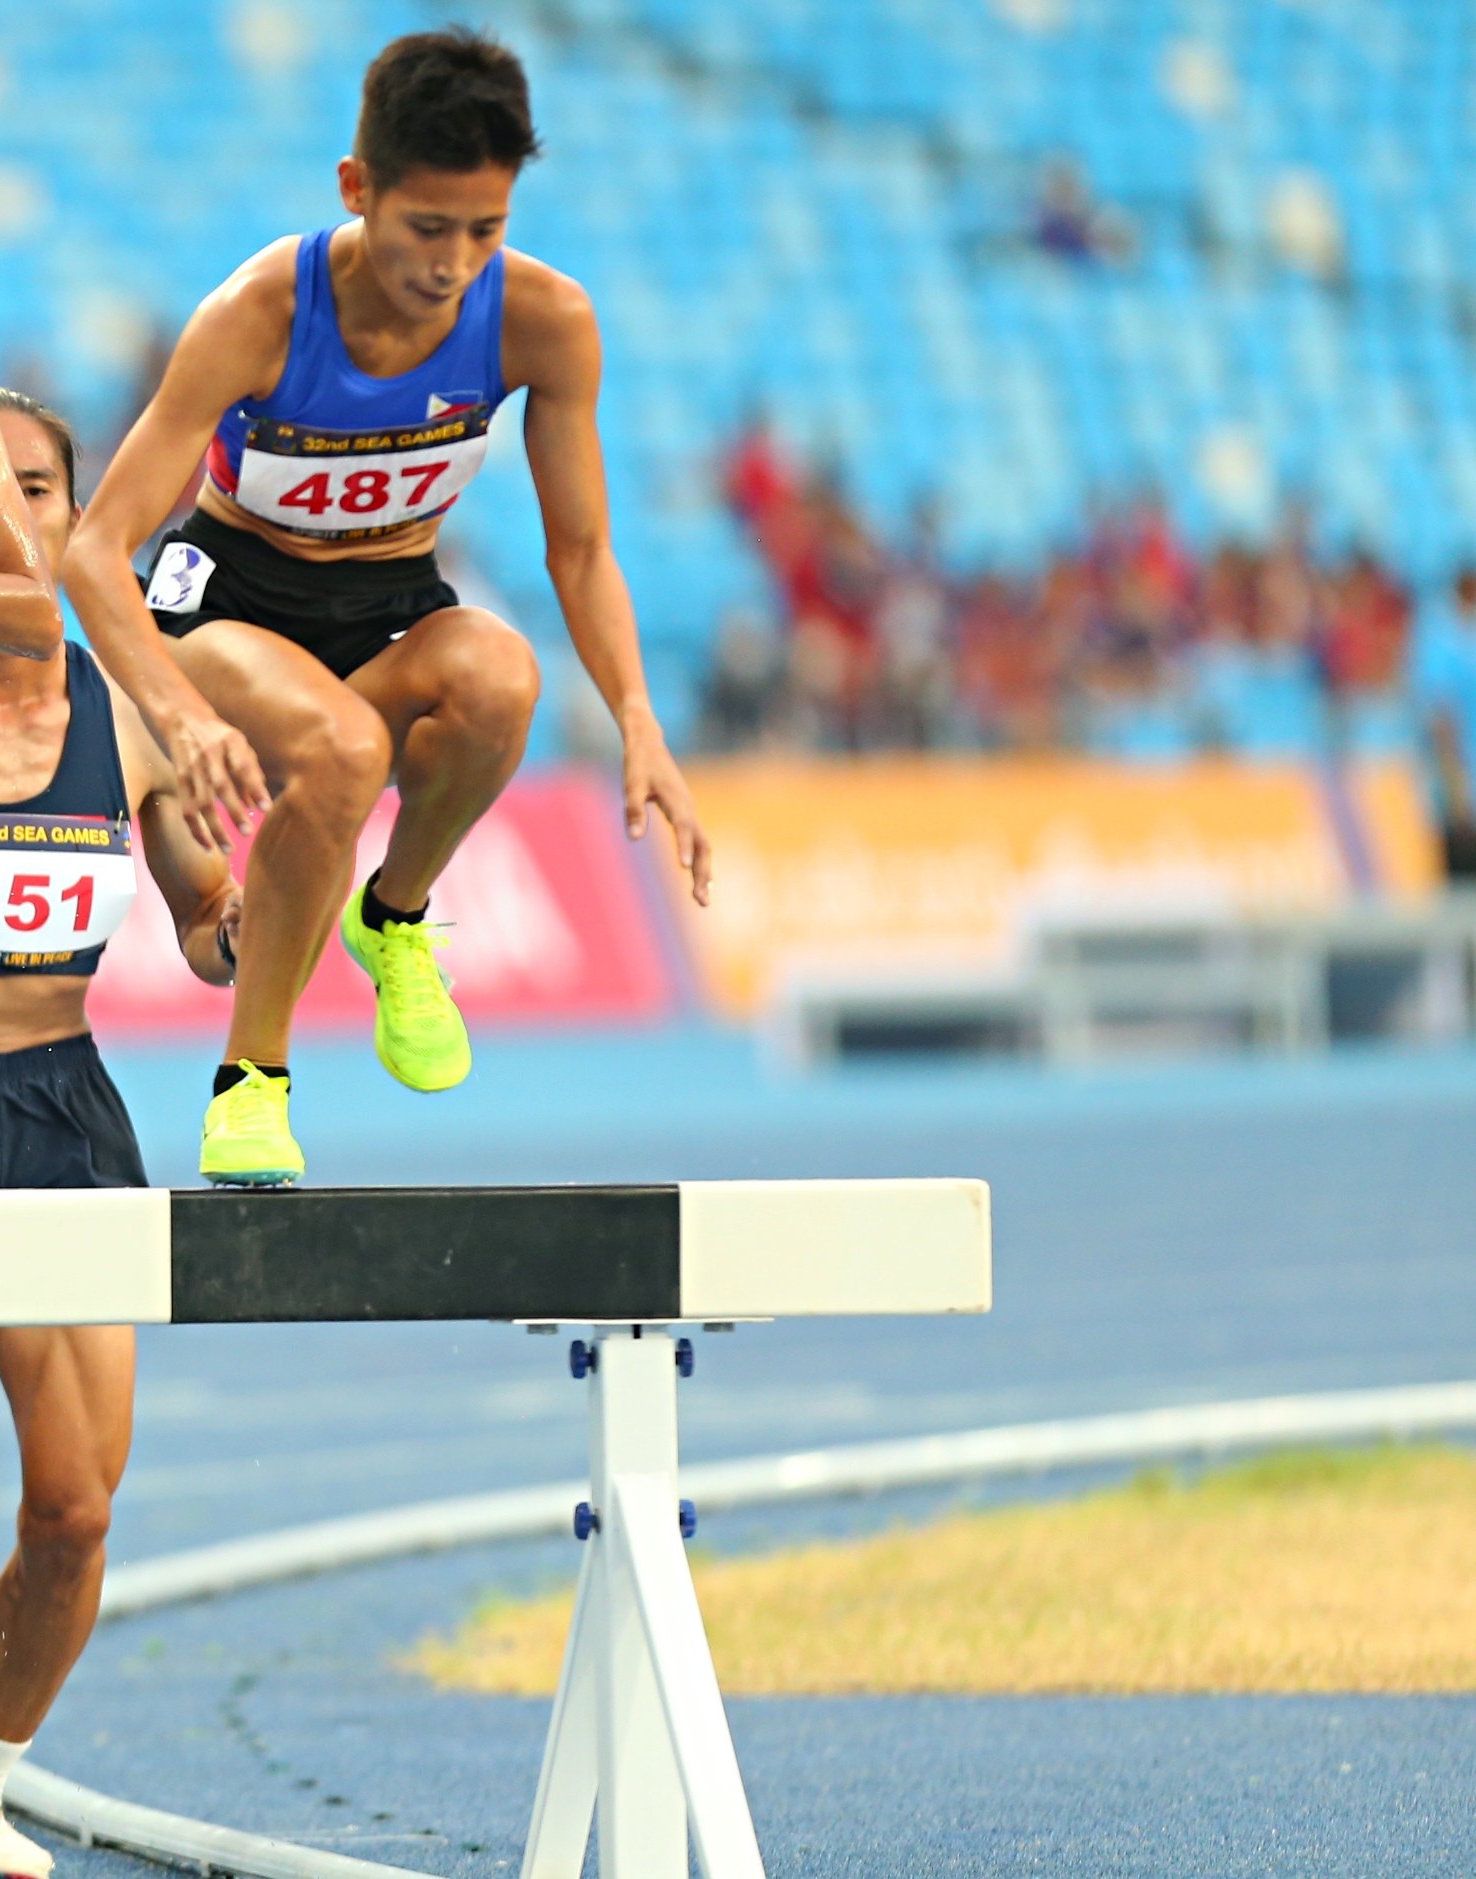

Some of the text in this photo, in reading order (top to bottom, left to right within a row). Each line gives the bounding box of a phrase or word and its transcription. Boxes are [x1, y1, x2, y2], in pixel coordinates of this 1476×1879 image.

[303, 420, 466, 452] 32nd SEA GAMES
[278, 460, 451, 516] 487
[13, 825, 47, 843] SEA
[51, 826, 110, 846] GAMES
